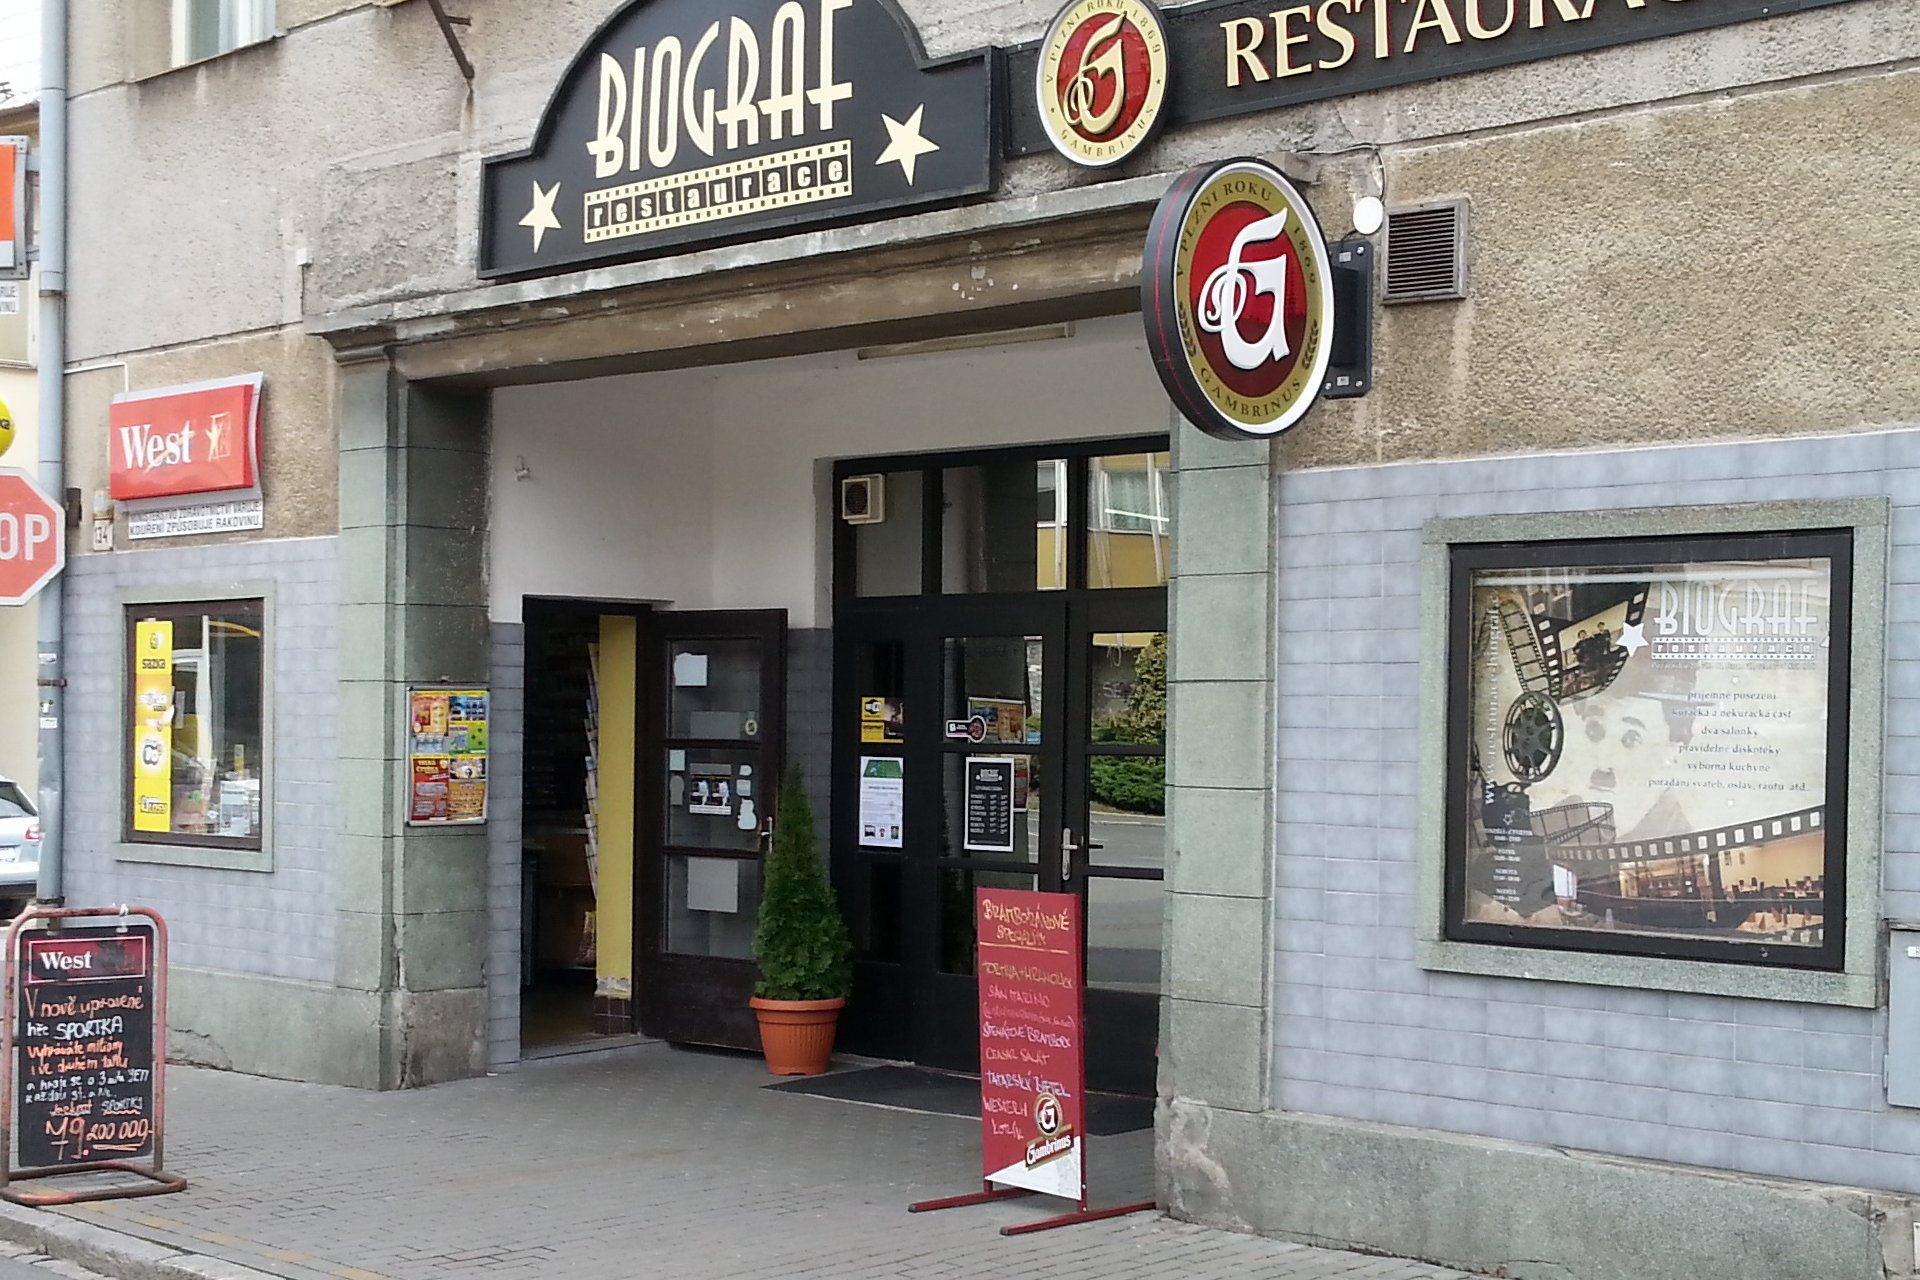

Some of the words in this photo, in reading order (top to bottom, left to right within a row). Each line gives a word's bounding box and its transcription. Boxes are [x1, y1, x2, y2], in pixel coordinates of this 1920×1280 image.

[1132, 9, 1161, 53] 1869
[1219, 0, 1690, 87] RESTAU
[586, 0, 853, 178] BIOGRAF
[1062, 107, 1154, 157] GAMBRINUS
[592, 157, 844, 227] restaurace
[1180, 192, 1219, 252] PLZNI
[1224, 180, 1272, 201] ROKU
[1200, 366, 1301, 417] GAMBRINUS
[120, 420, 193, 471] West
[1653, 579, 1818, 636] BIOGRAF
[1655, 644, 1812, 654] restaurace
[1701, 726, 1718, 735] dva
[40, 951, 92, 971] West
[25, 987, 39, 1018] V
[53, 1015, 123, 1040] SPORTKA
[1027, 1135, 1072, 1165] Gambrinus
